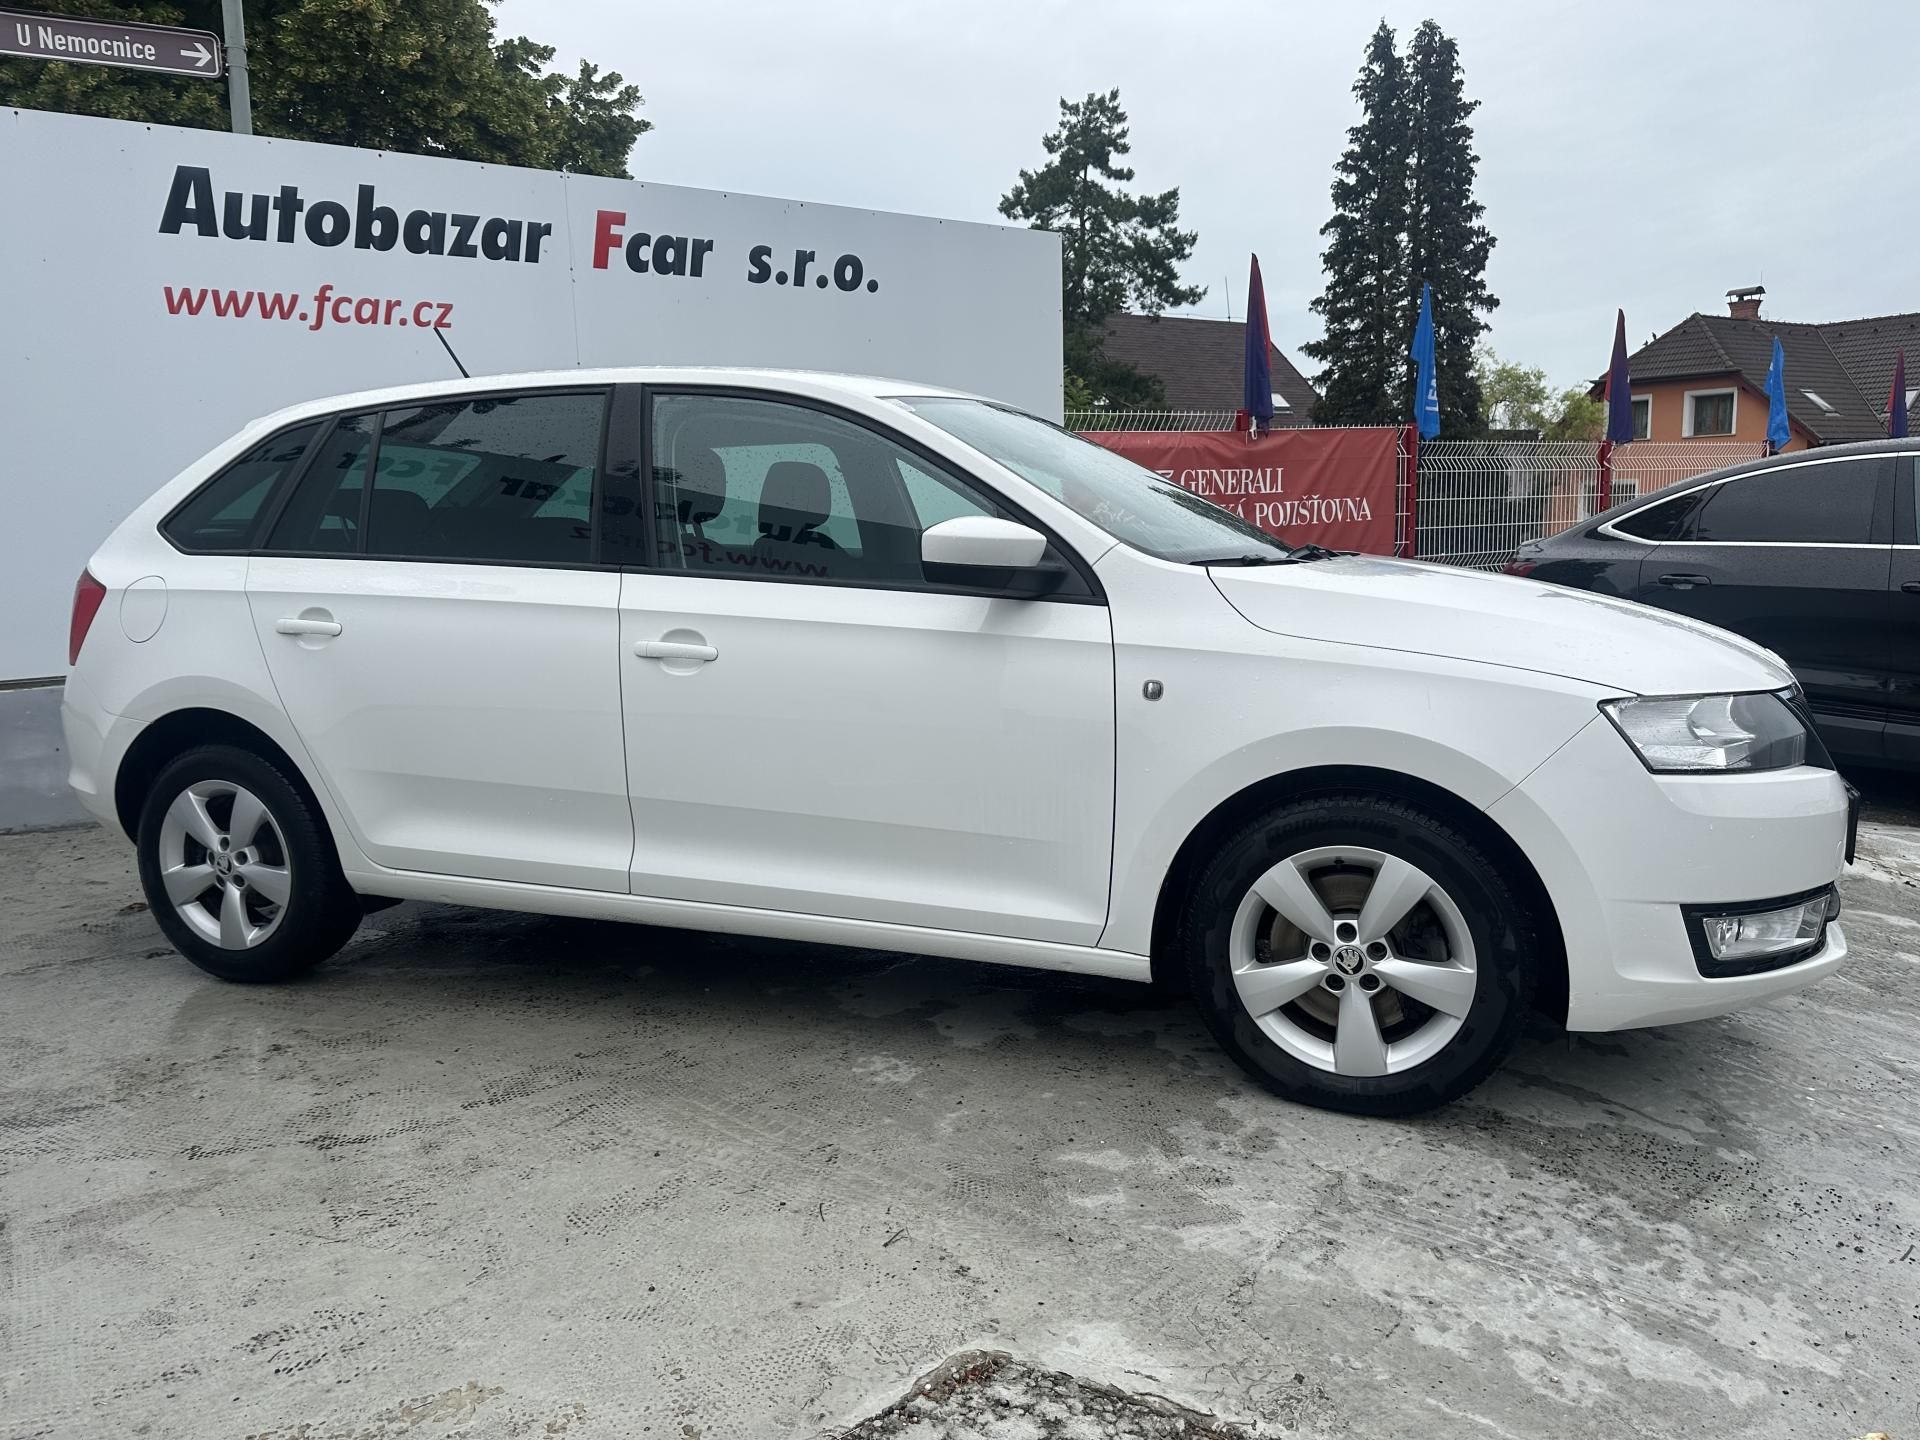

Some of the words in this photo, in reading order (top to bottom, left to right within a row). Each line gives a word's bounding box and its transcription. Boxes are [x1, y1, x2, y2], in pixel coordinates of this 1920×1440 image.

[16, 23, 31, 46] U
[38, 26, 156, 61] Nemocnice
[158, 165, 552, 264] Autobazar
[593, 210, 714, 278] Fcar
[747, 244, 880, 294] s.r.o.
[164, 284, 454, 330] www.fcar.cz
[1180, 467, 1285, 496] GENERALI
[1254, 494, 1373, 528] POJIŠŤOVNA
